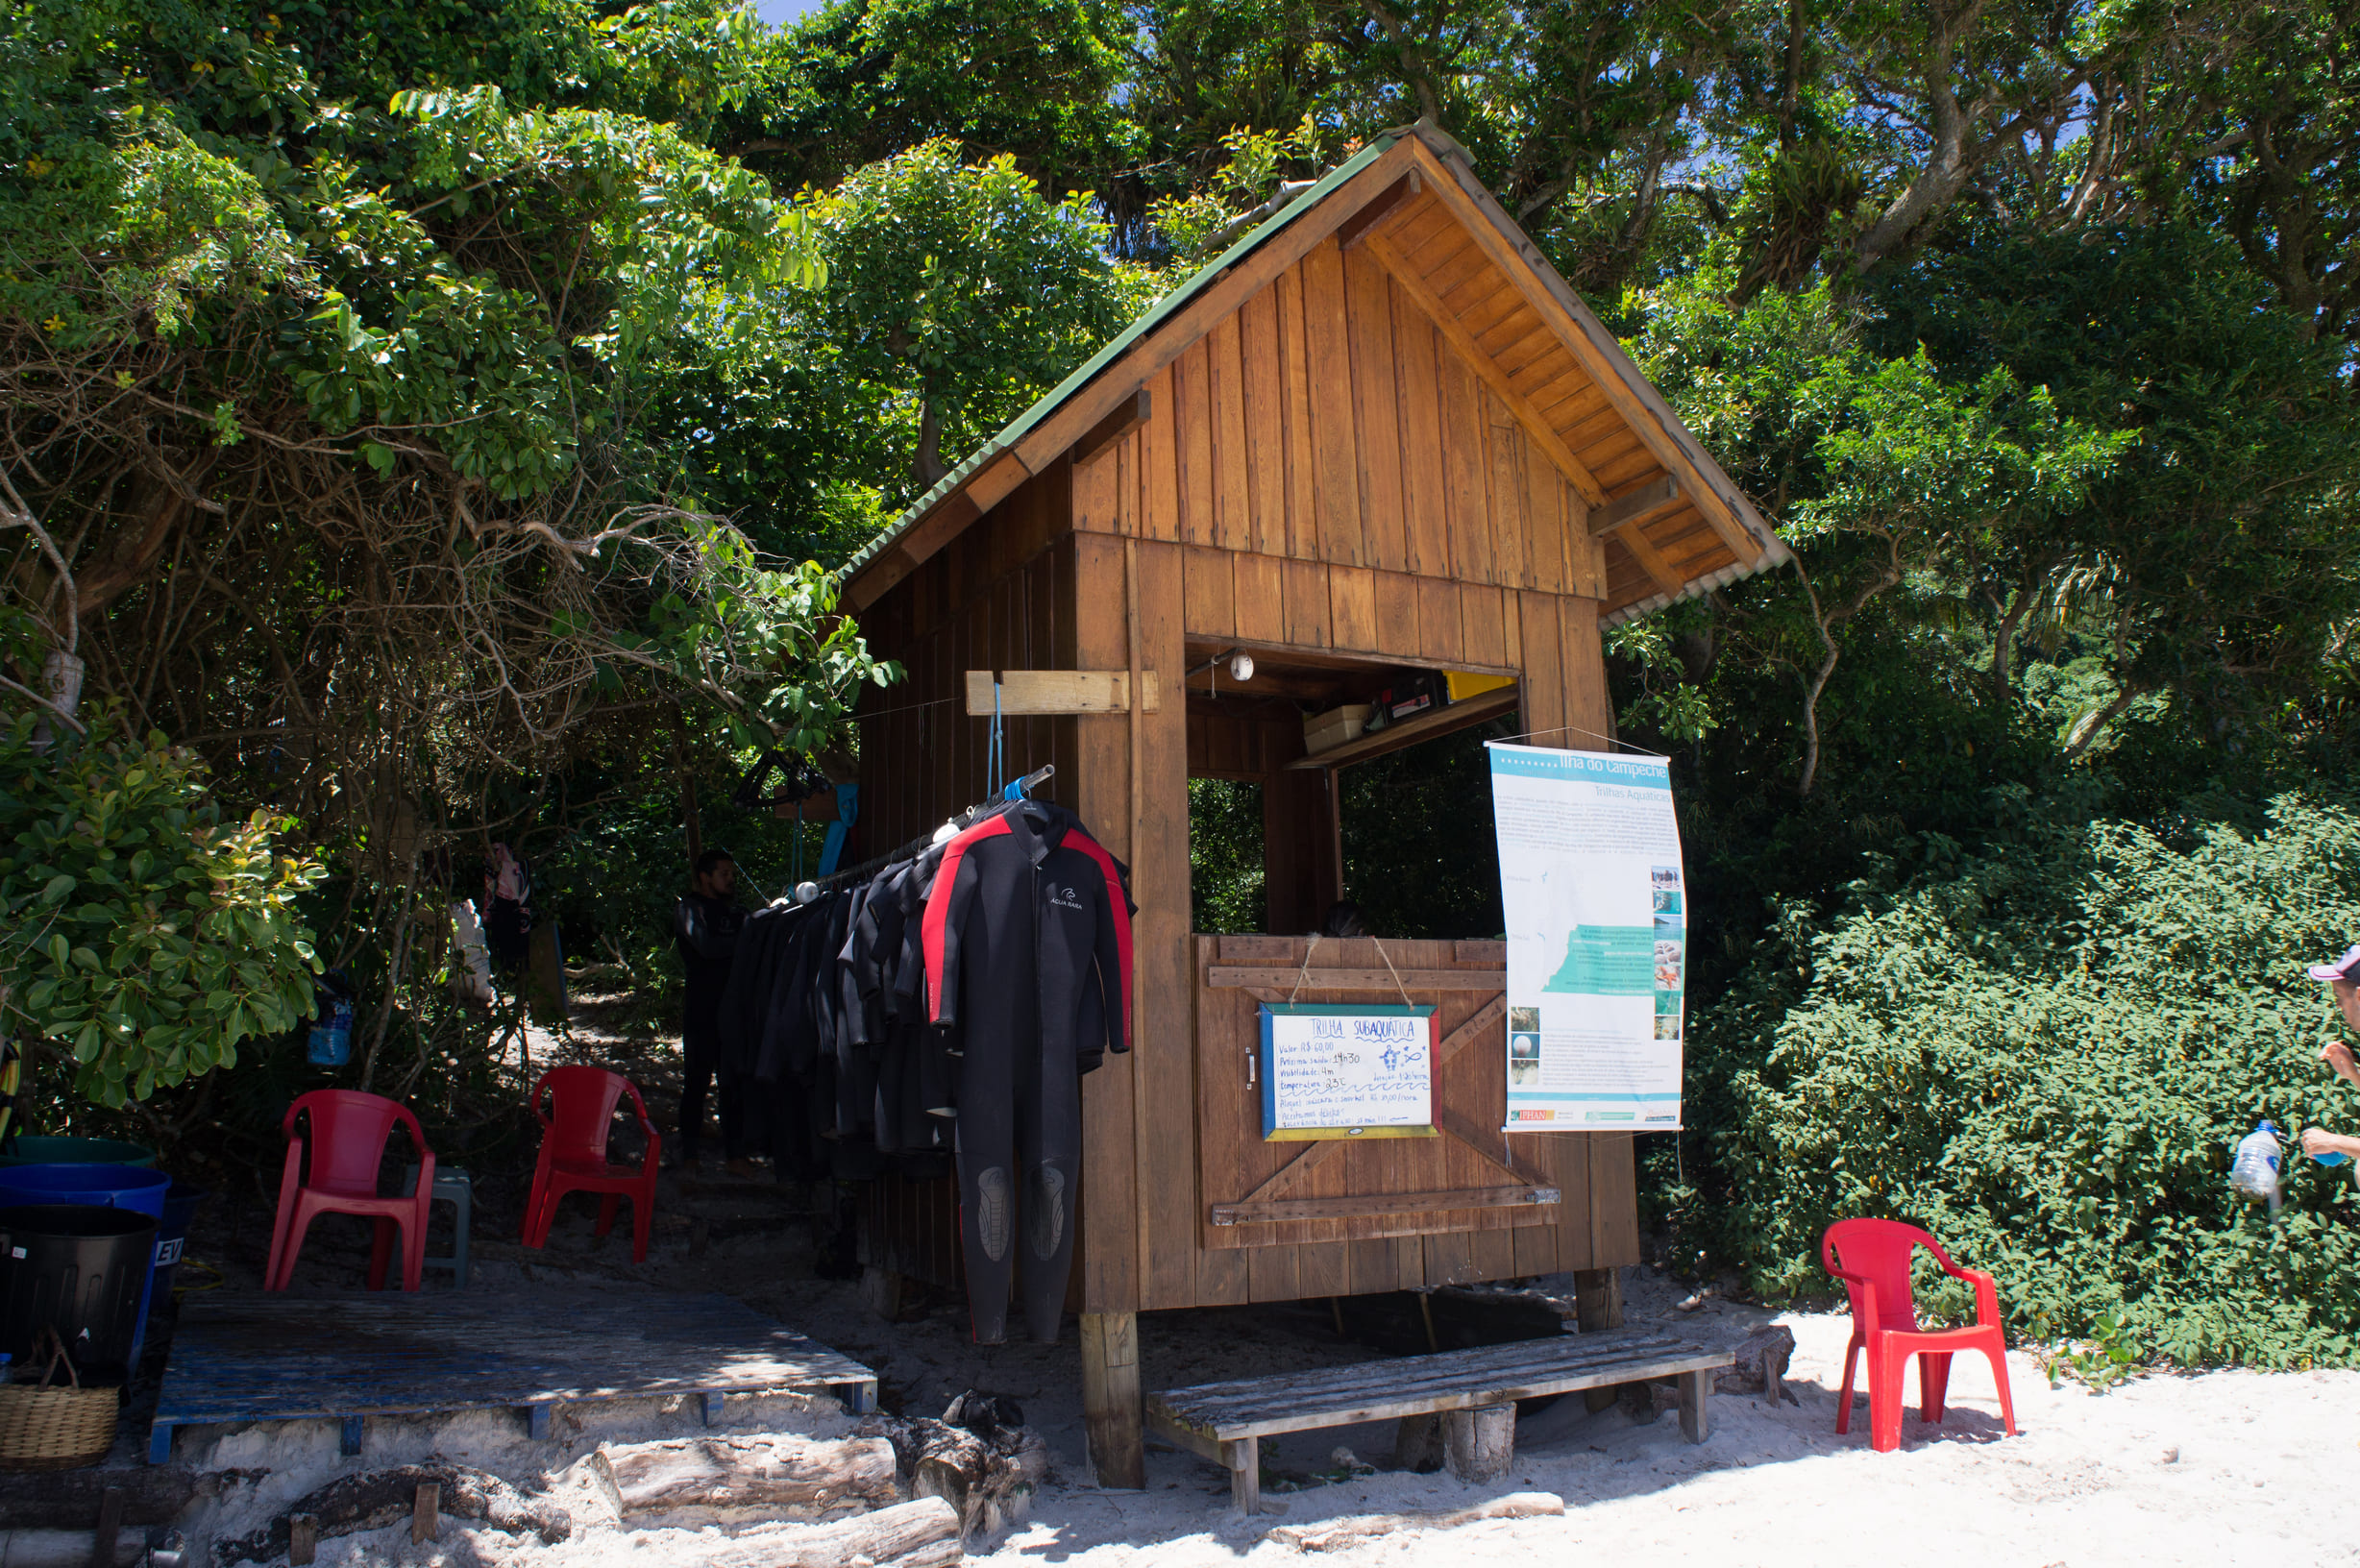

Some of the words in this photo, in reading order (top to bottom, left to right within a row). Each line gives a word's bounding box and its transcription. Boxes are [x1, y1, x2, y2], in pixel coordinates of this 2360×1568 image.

[1561, 755, 1585, 769] Ilha
[1586, 759, 1603, 772] do
[1606, 760, 1667, 779] Campeche
[1594, 786, 1625, 798] Trilhas
[1627, 789, 1670, 803] Aquáticas
[1310, 1018, 1343, 1035] TRILHA
[1353, 1017, 1414, 1039] SUBAQUÁTICA
[1279, 1045, 1297, 1054] Valor
[1301, 1041, 1311, 1052] R$
[1314, 1041, 1334, 1054] 60,00
[1333, 1052, 1360, 1064] 14h30
[1520, 1110, 1546, 1121] IPHAN
